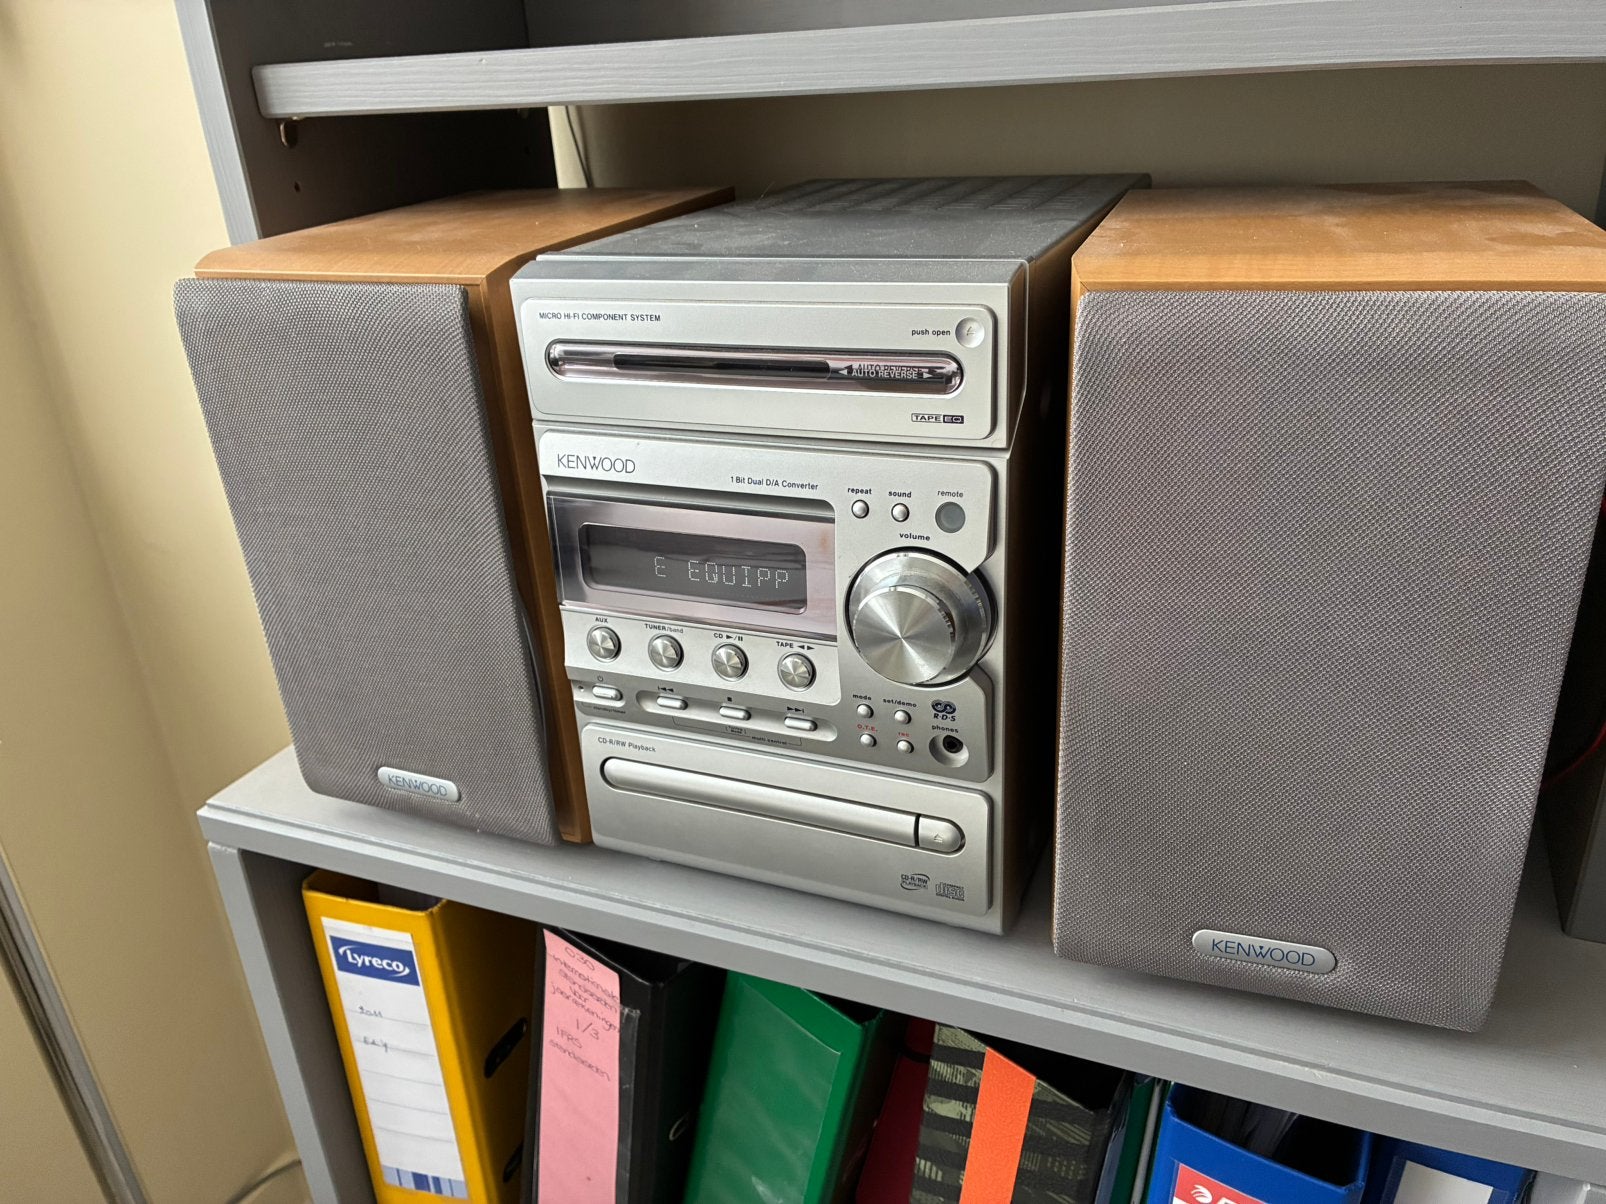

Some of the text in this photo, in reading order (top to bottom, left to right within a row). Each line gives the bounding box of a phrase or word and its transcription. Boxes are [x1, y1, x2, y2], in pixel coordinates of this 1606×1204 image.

[539, 312, 661, 322] MICRO HI-FI COMPONENT SYSTEM
[911, 328, 951, 337] push open
[852, 369, 918, 379] AUTO REVERSE
[914, 414, 964, 424] TAPE EQ
[557, 453, 636, 474] KENWOOD
[735, 476, 746, 484] Bit
[747, 477, 764, 486] Dual
[765, 478, 780, 487] D/A
[781, 480, 819, 491] Converter
[847, 487, 872, 497] repeat
[888, 490, 912, 499] sound
[937, 489, 964, 499] remote
[899, 532, 931, 542] volume
[654, 556, 789, 589] E EQUIPP
[595, 616, 608, 624] AUX
[713, 632, 724, 640] CD
[776, 641, 794, 649] TAPE
[852, 693, 872, 701] mode
[931, 724, 959, 734] phones
[597, 736, 656, 753] CD-R/RW Playback
[387, 774, 448, 798] KENWOOD
[1211, 938, 1316, 968] KENWOOD
[346, 949, 404, 973] Lyreco
